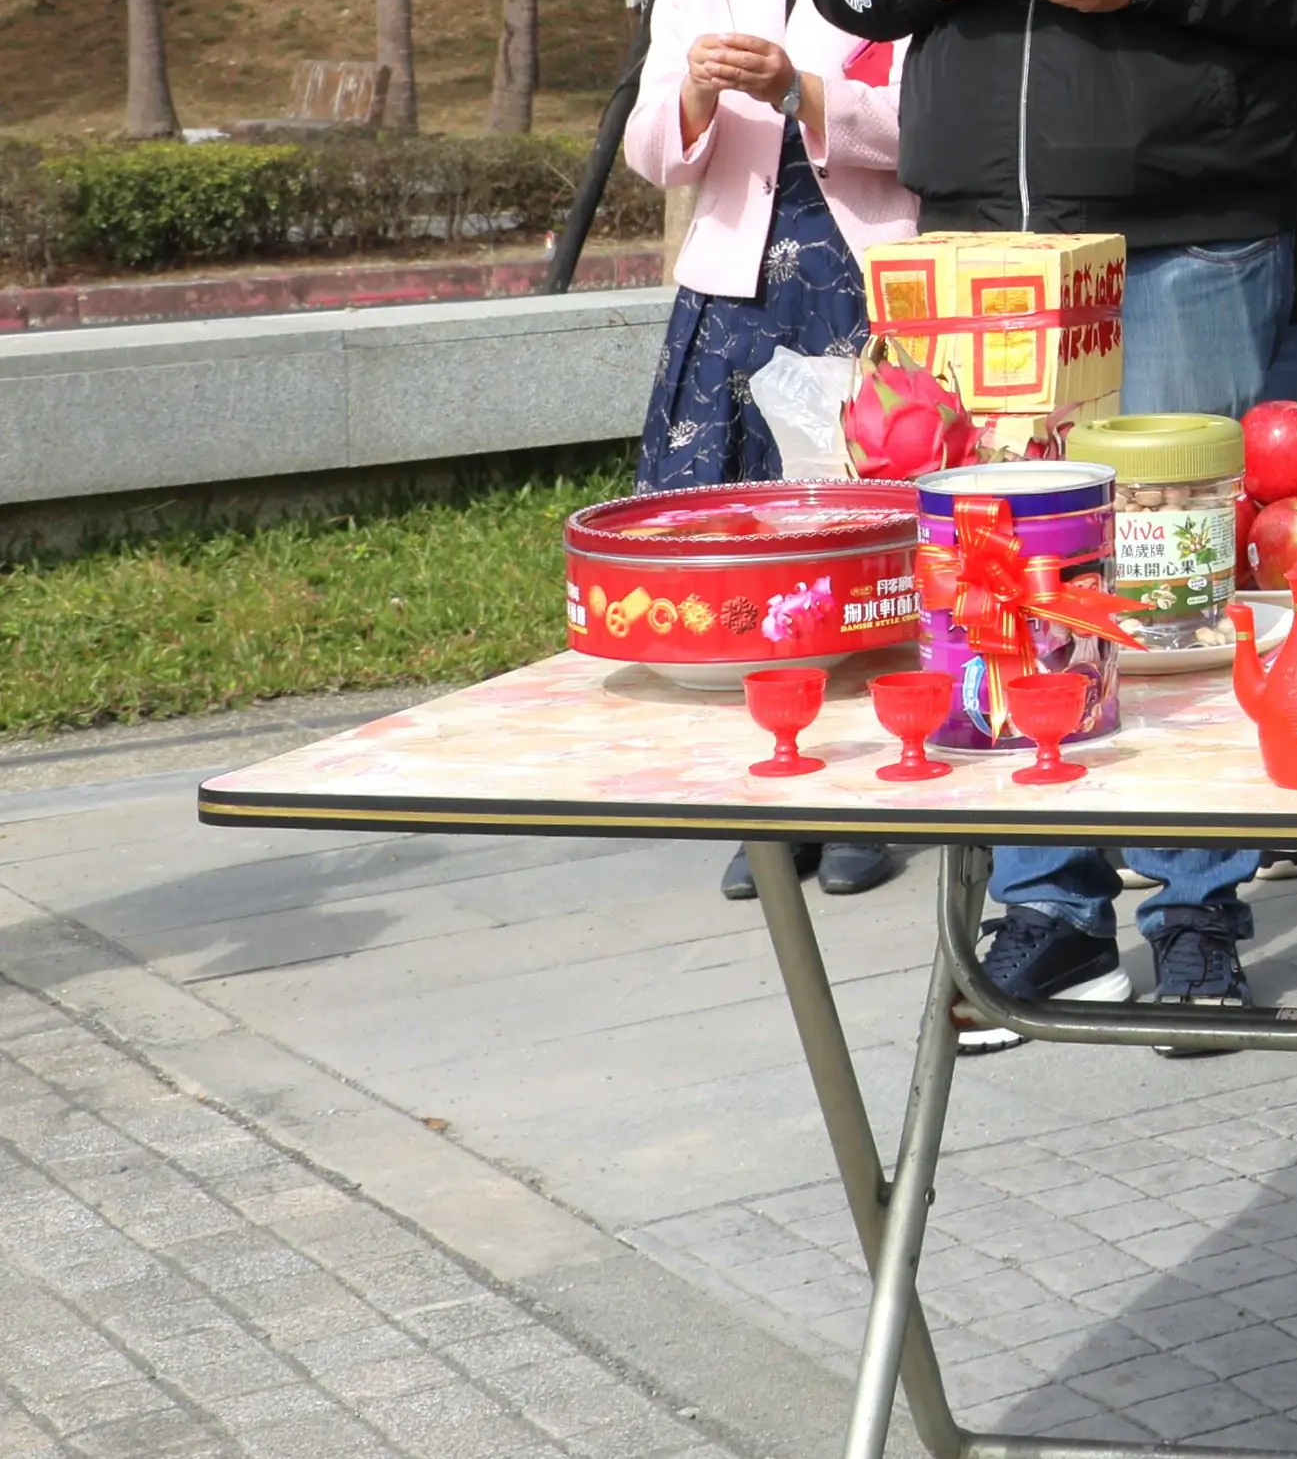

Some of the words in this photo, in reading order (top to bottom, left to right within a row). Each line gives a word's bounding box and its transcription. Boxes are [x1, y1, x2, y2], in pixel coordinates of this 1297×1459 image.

[1121, 544, 1165, 559] 萬歲牌
[840, 622, 873, 633] DANISH
[875, 618, 900, 628] STYLE
